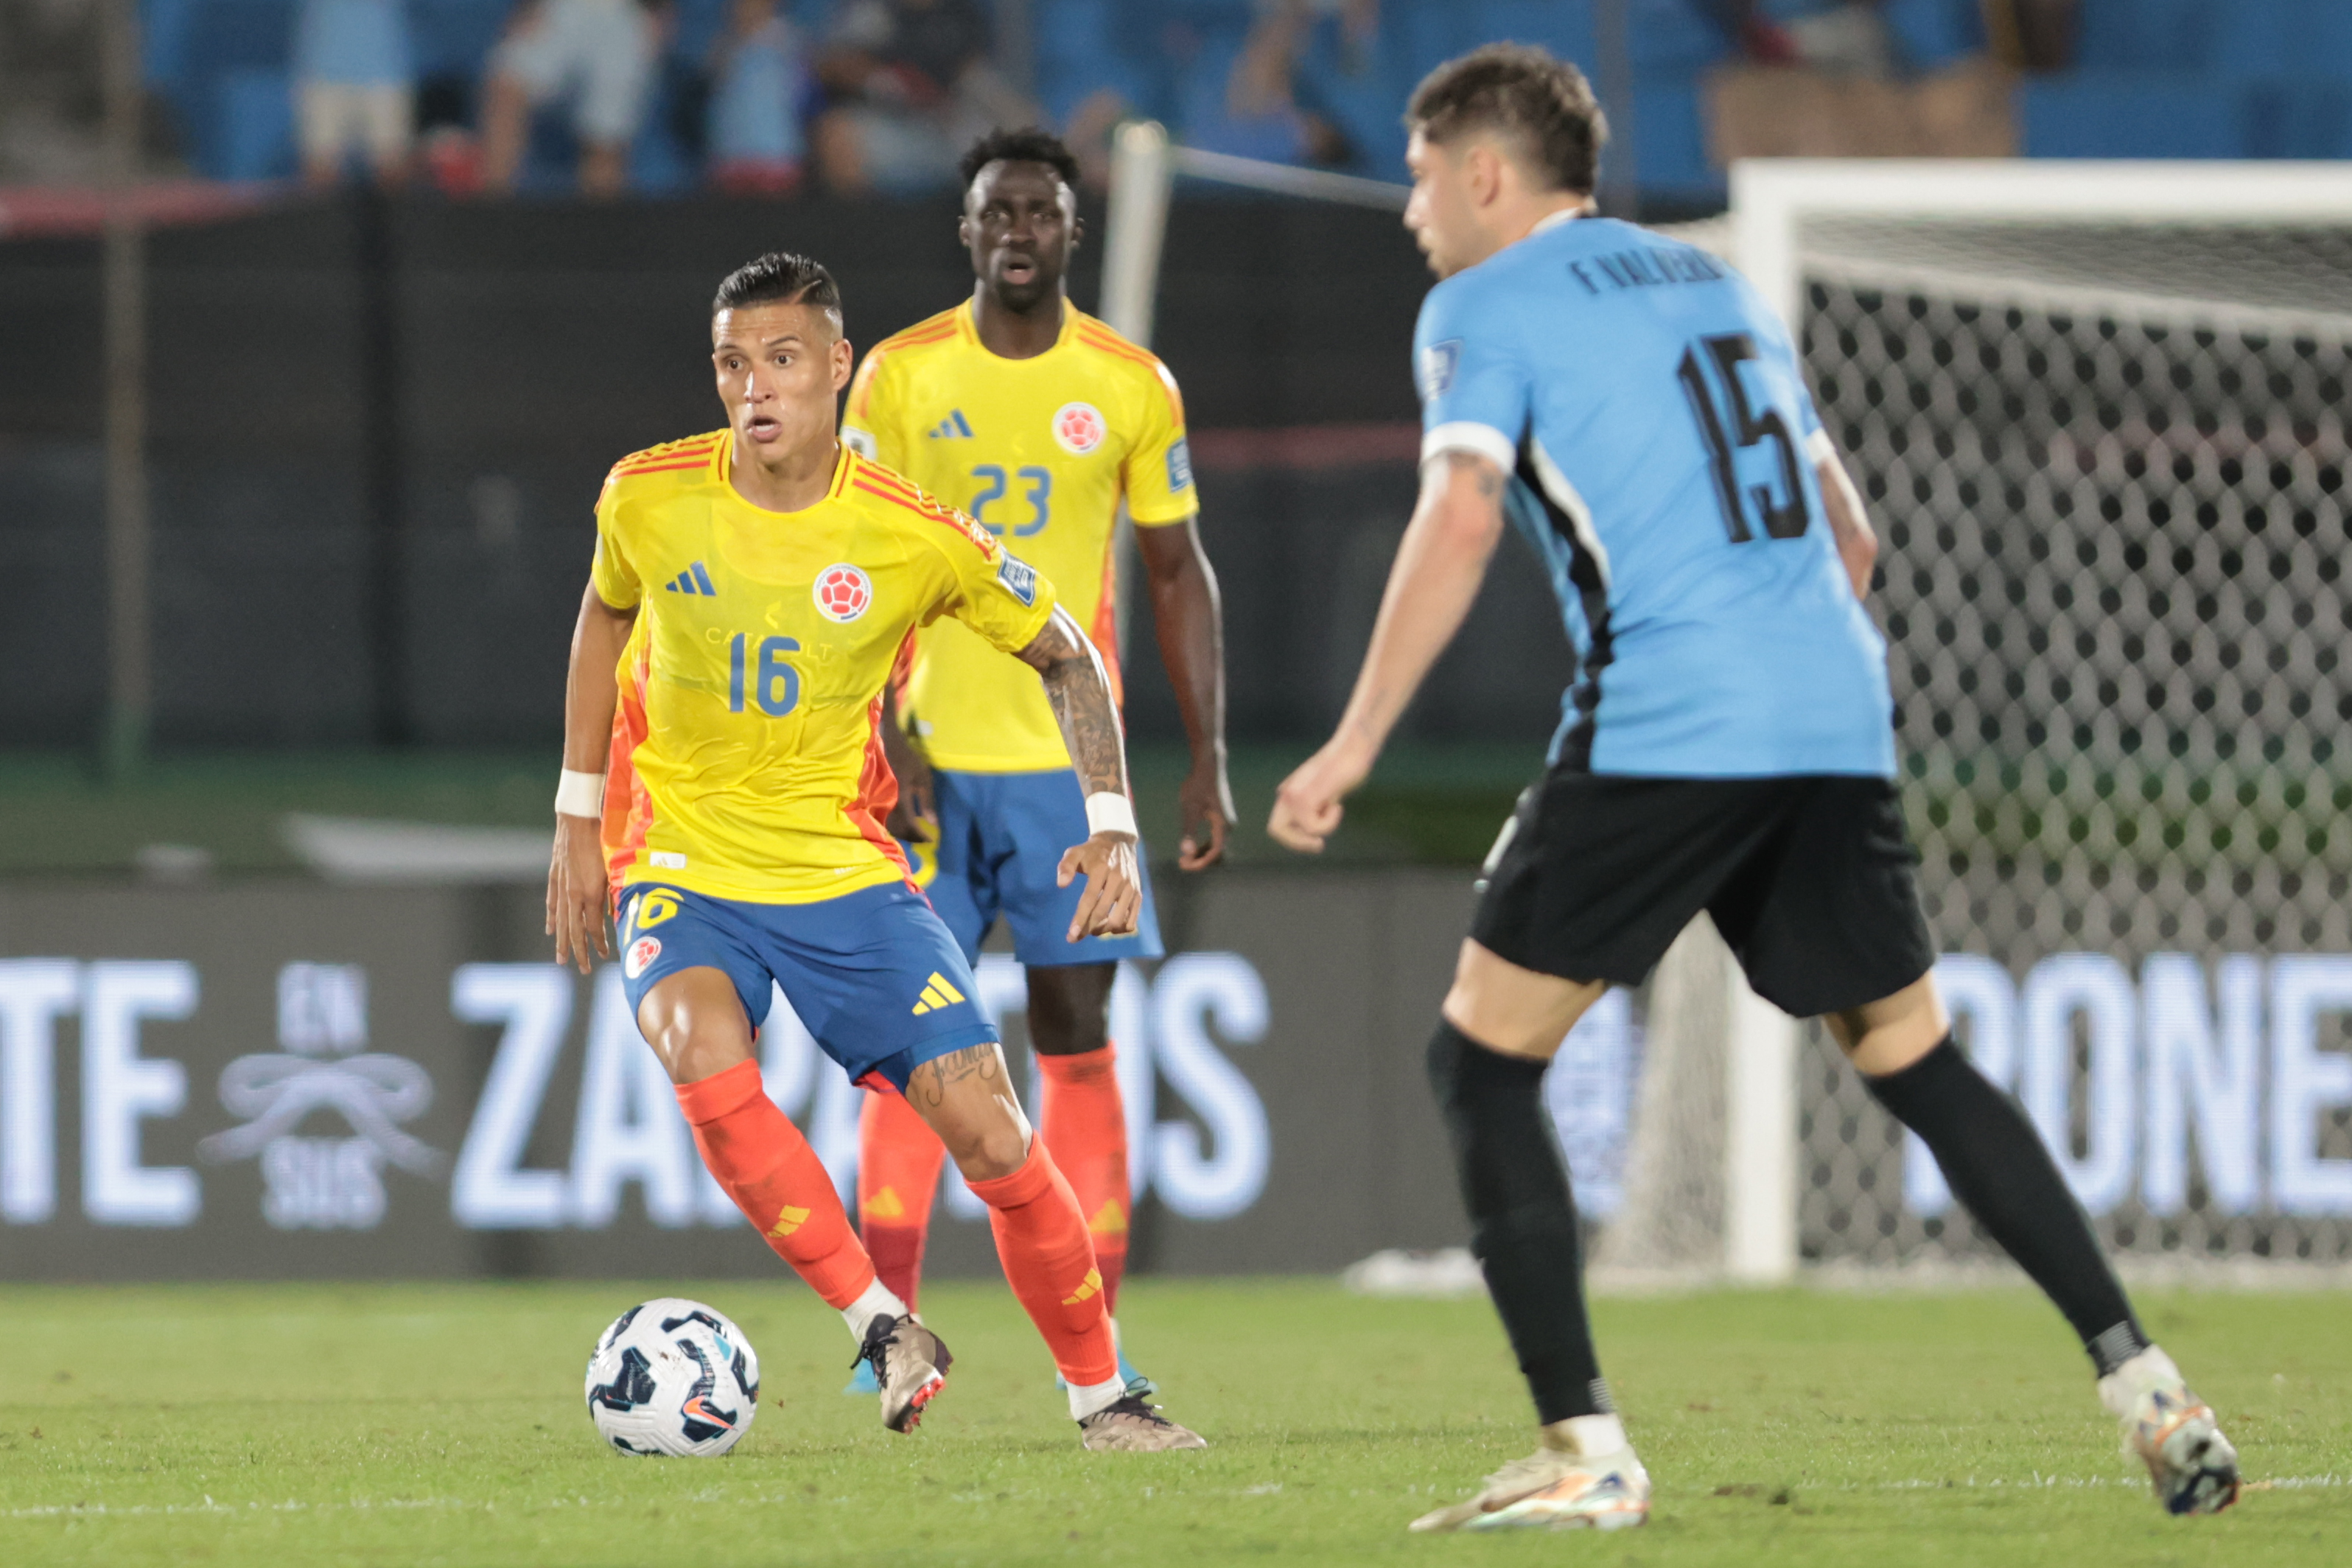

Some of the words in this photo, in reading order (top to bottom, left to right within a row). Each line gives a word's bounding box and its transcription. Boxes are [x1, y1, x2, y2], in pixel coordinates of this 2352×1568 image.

[1676, 332, 1810, 543] 15
[970, 464, 1051, 537] 23
[729, 632, 801, 717] 16
[623, 887, 685, 946] 16
[0, 957, 202, 1227] TE
